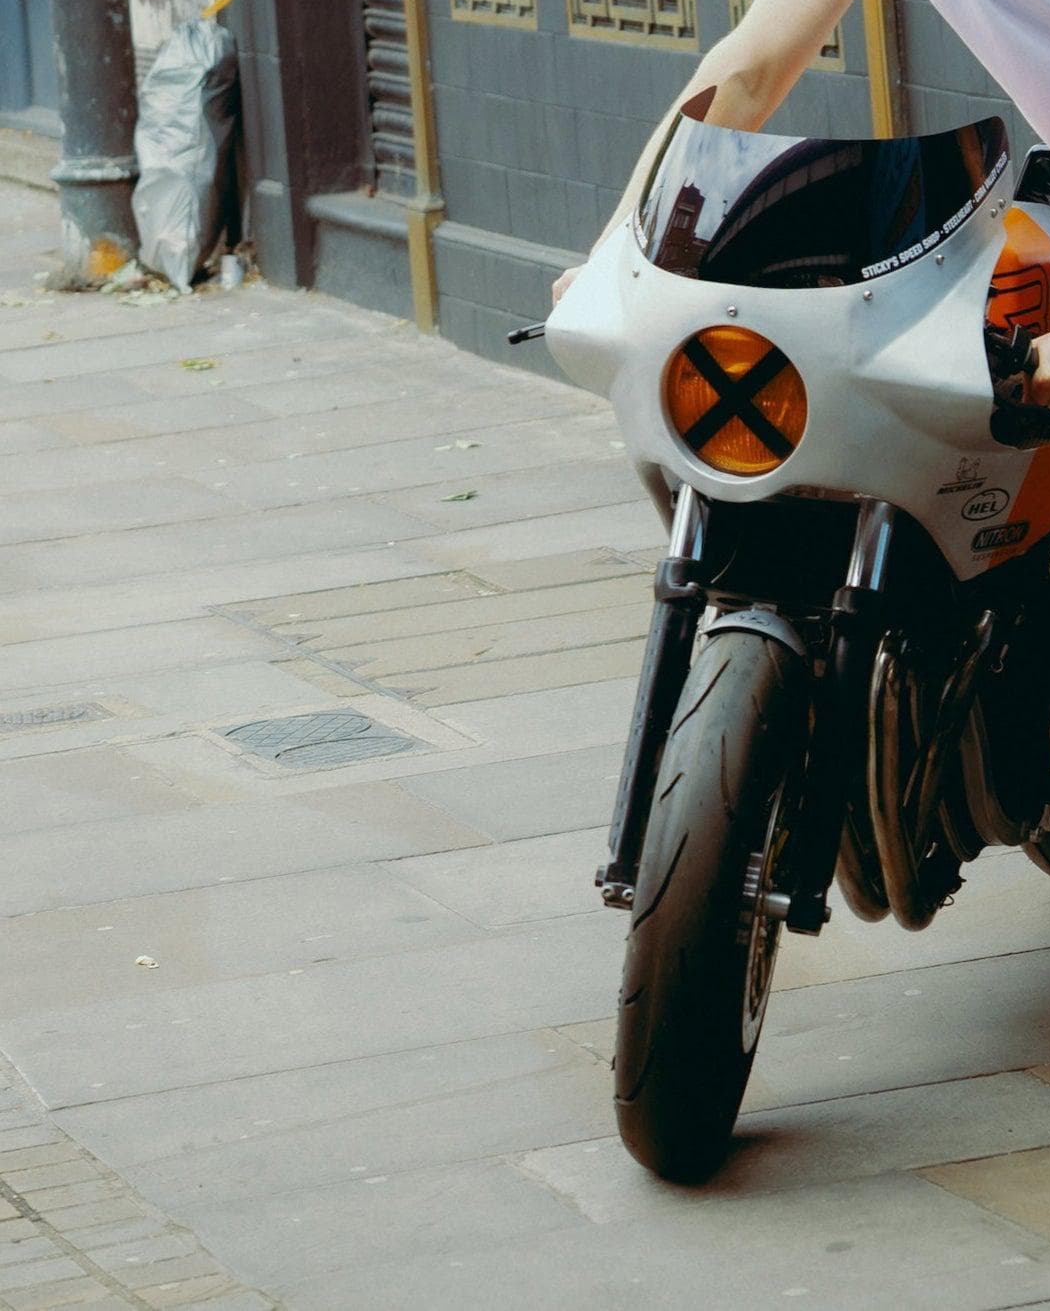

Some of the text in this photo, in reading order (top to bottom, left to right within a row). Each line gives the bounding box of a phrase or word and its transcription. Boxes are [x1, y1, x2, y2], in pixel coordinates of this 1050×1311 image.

[861, 255, 899, 279] STICKY'S
[898, 242, 924, 264] SPEED
[968, 500, 999, 516] HEL
